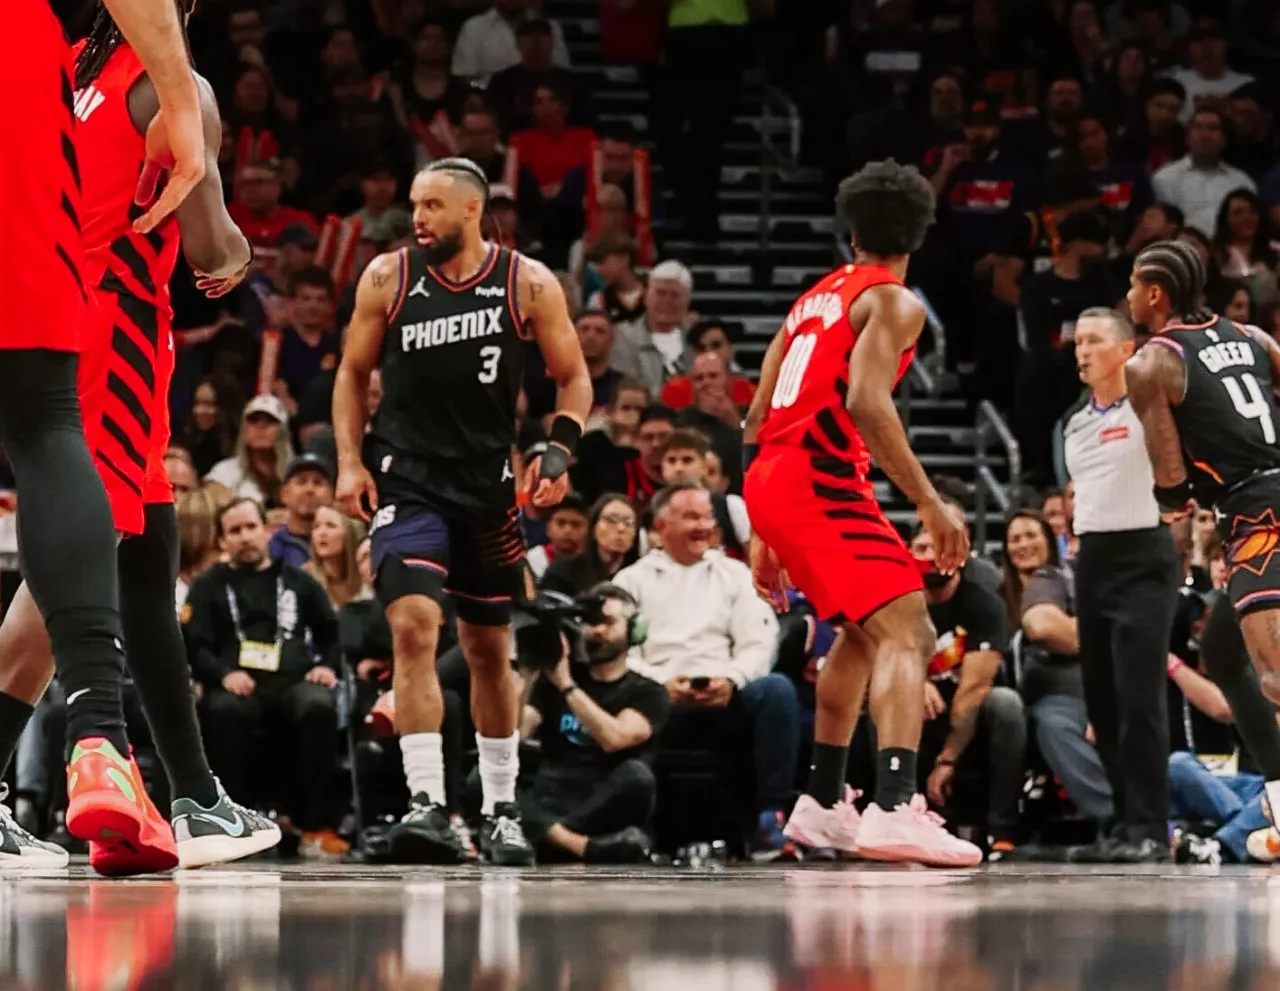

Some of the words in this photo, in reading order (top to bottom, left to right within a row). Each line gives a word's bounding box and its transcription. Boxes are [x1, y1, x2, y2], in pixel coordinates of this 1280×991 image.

[400, 305, 504, 353] PHOENIX
[477, 345, 503, 385] 3
[1197, 340, 1256, 374] GREEN
[1220, 372, 1277, 445] 4
